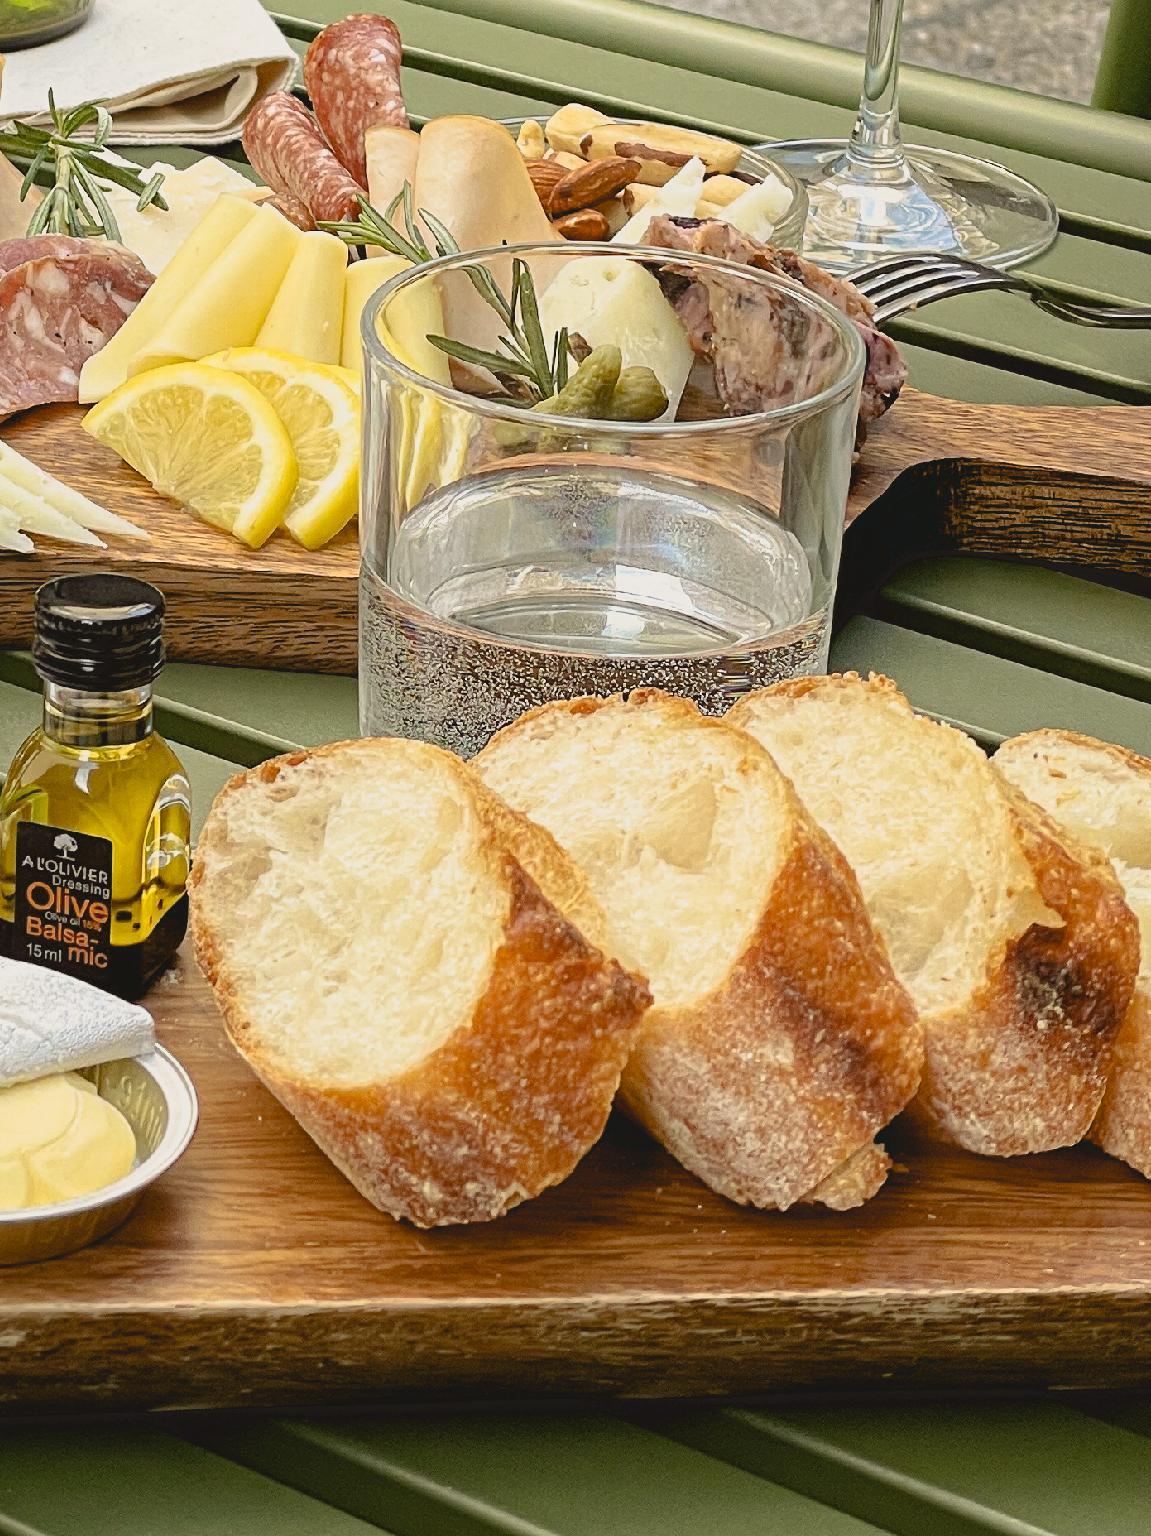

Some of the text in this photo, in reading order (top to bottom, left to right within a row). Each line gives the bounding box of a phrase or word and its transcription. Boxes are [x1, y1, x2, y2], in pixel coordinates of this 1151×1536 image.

[22, 855, 34, 868] A
[52, 874, 111, 900] Dressing
[26, 881, 109, 924] Olive
[68, 946, 108, 969] mic
